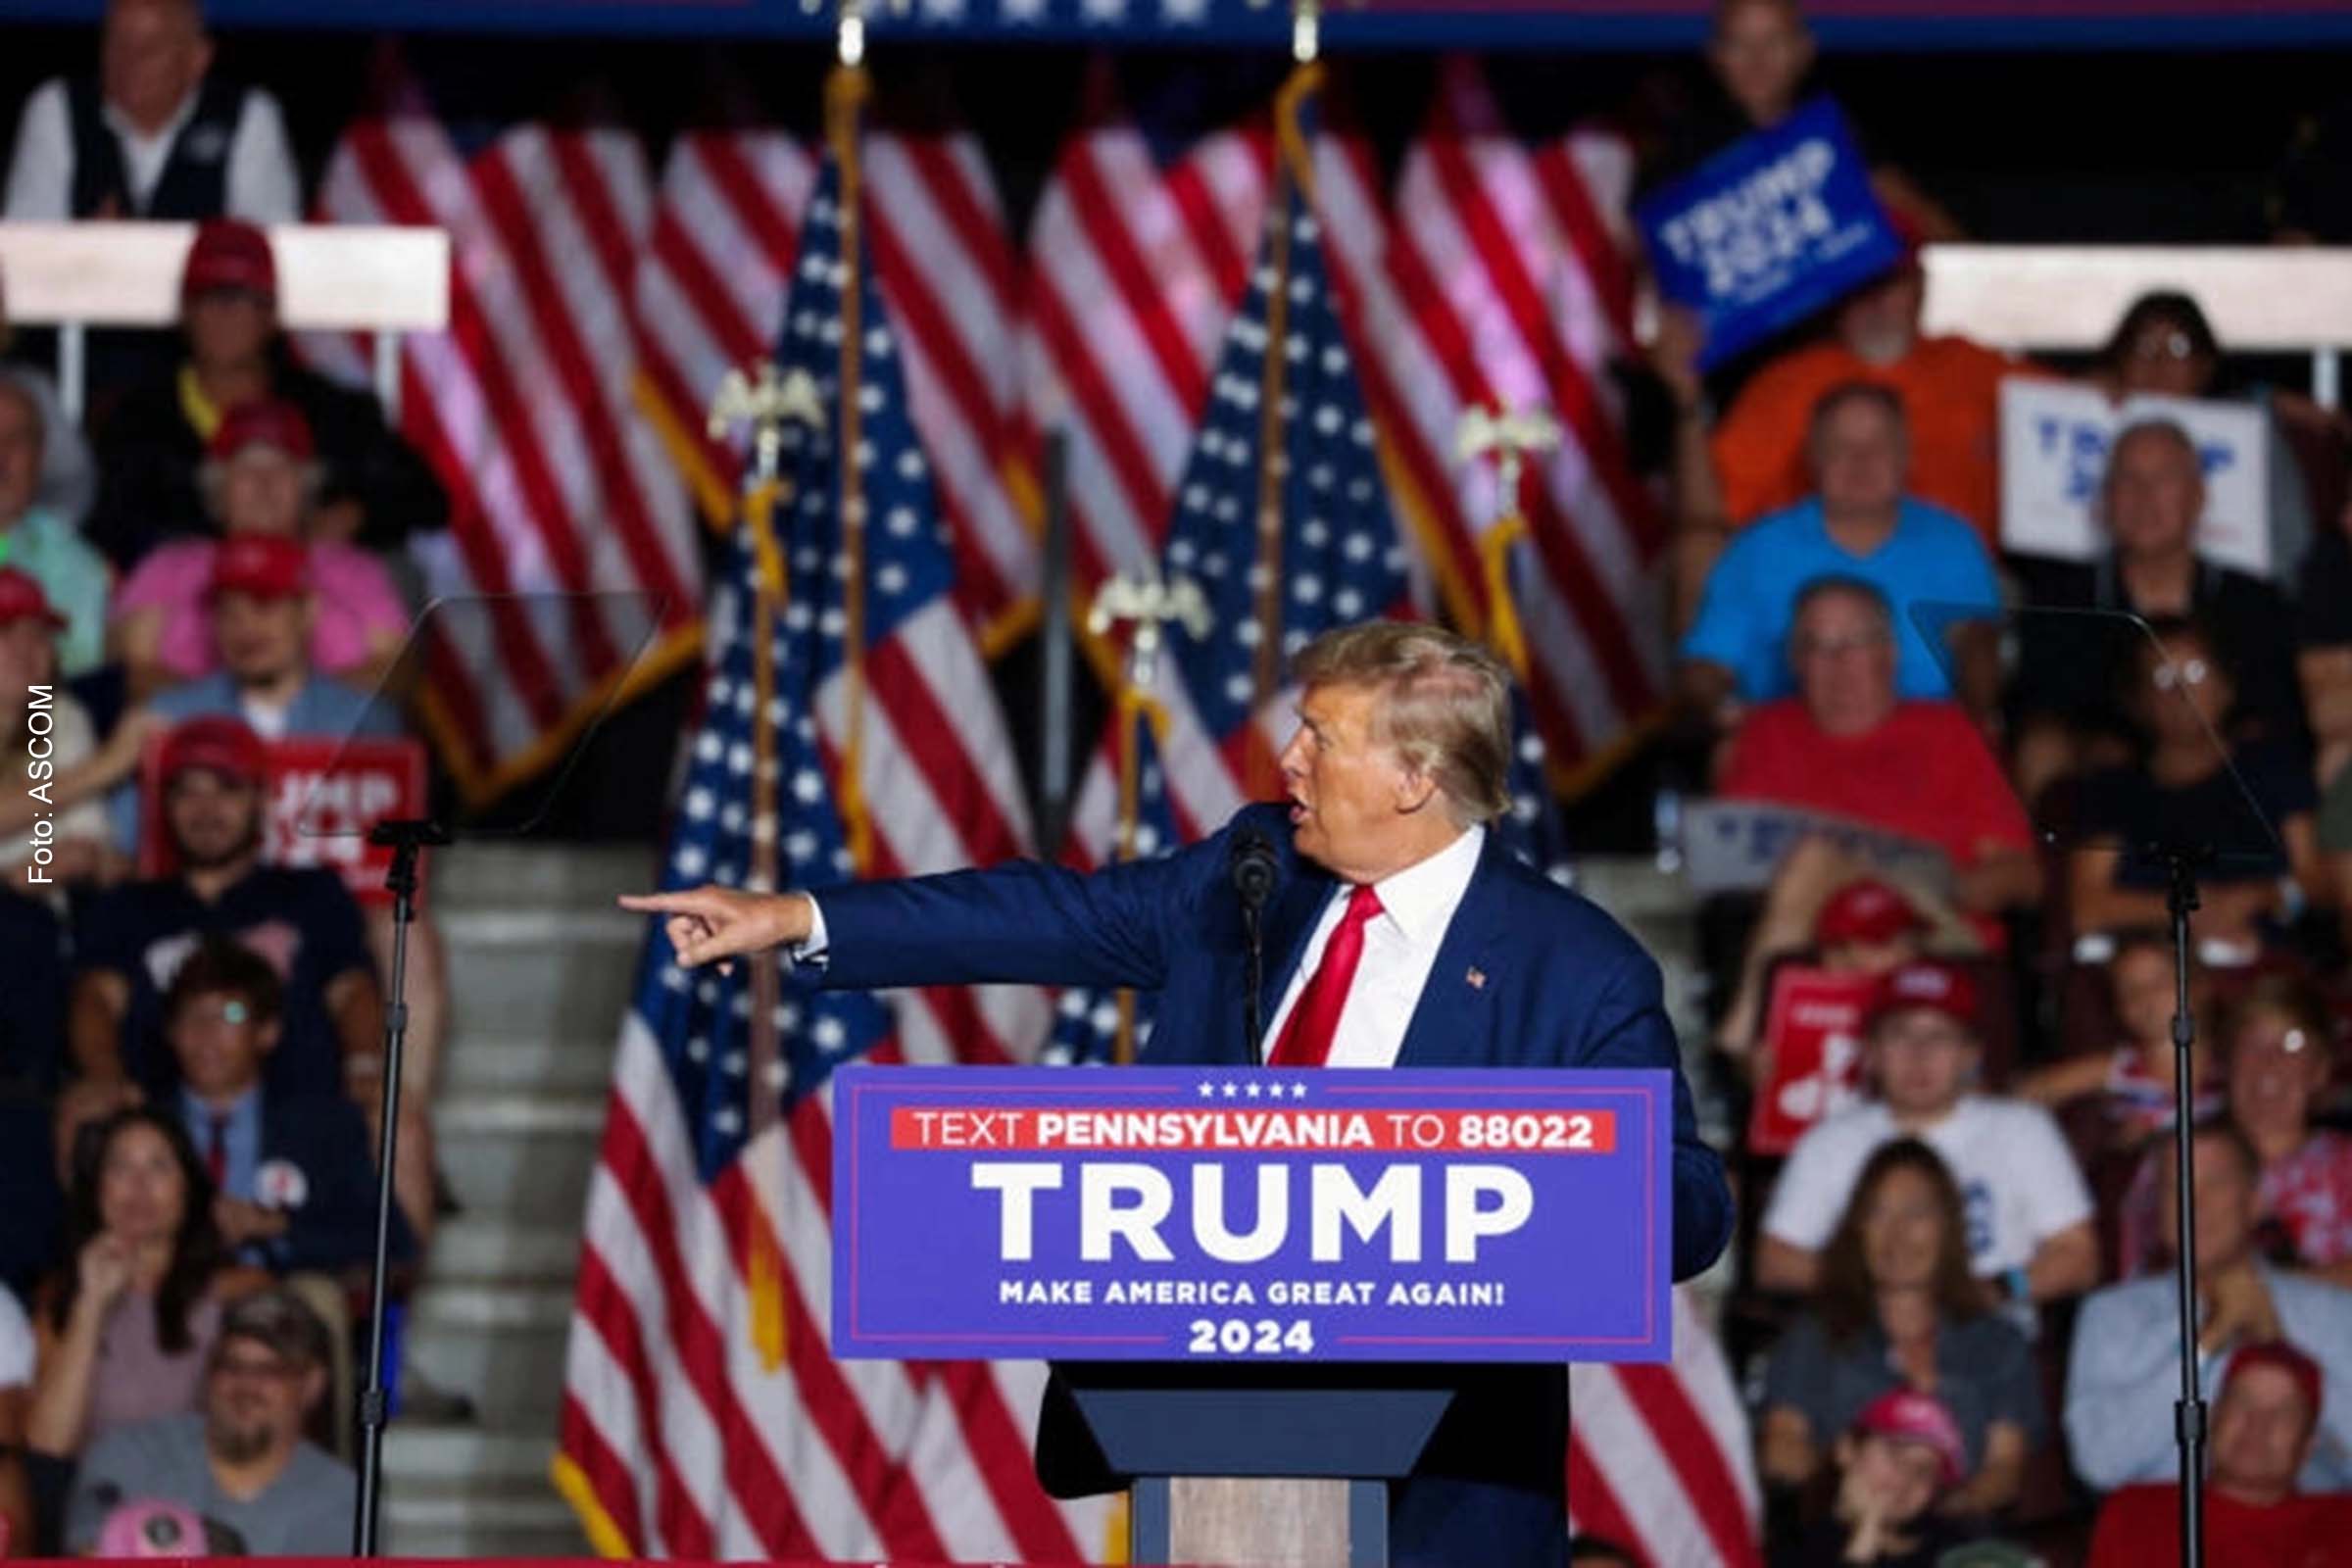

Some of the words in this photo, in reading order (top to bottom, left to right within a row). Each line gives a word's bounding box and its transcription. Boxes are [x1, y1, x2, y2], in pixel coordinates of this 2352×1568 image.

[914, 1112, 1022, 1146] TEXT
[1037, 1112, 1375, 1147] PENNSYLVANIA
[1387, 1114, 1445, 1148] TO
[1457, 1114, 1593, 1149] 88022
[971, 1162, 1535, 1263] TRUMP
[1000, 1280, 1092, 1304] MAKE
[1103, 1281, 1255, 1304] AMERICA
[1267, 1281, 1376, 1305] GREAT
[1387, 1282, 1505, 1305] AGAIN!
[1189, 1319, 1315, 1353] 2024
